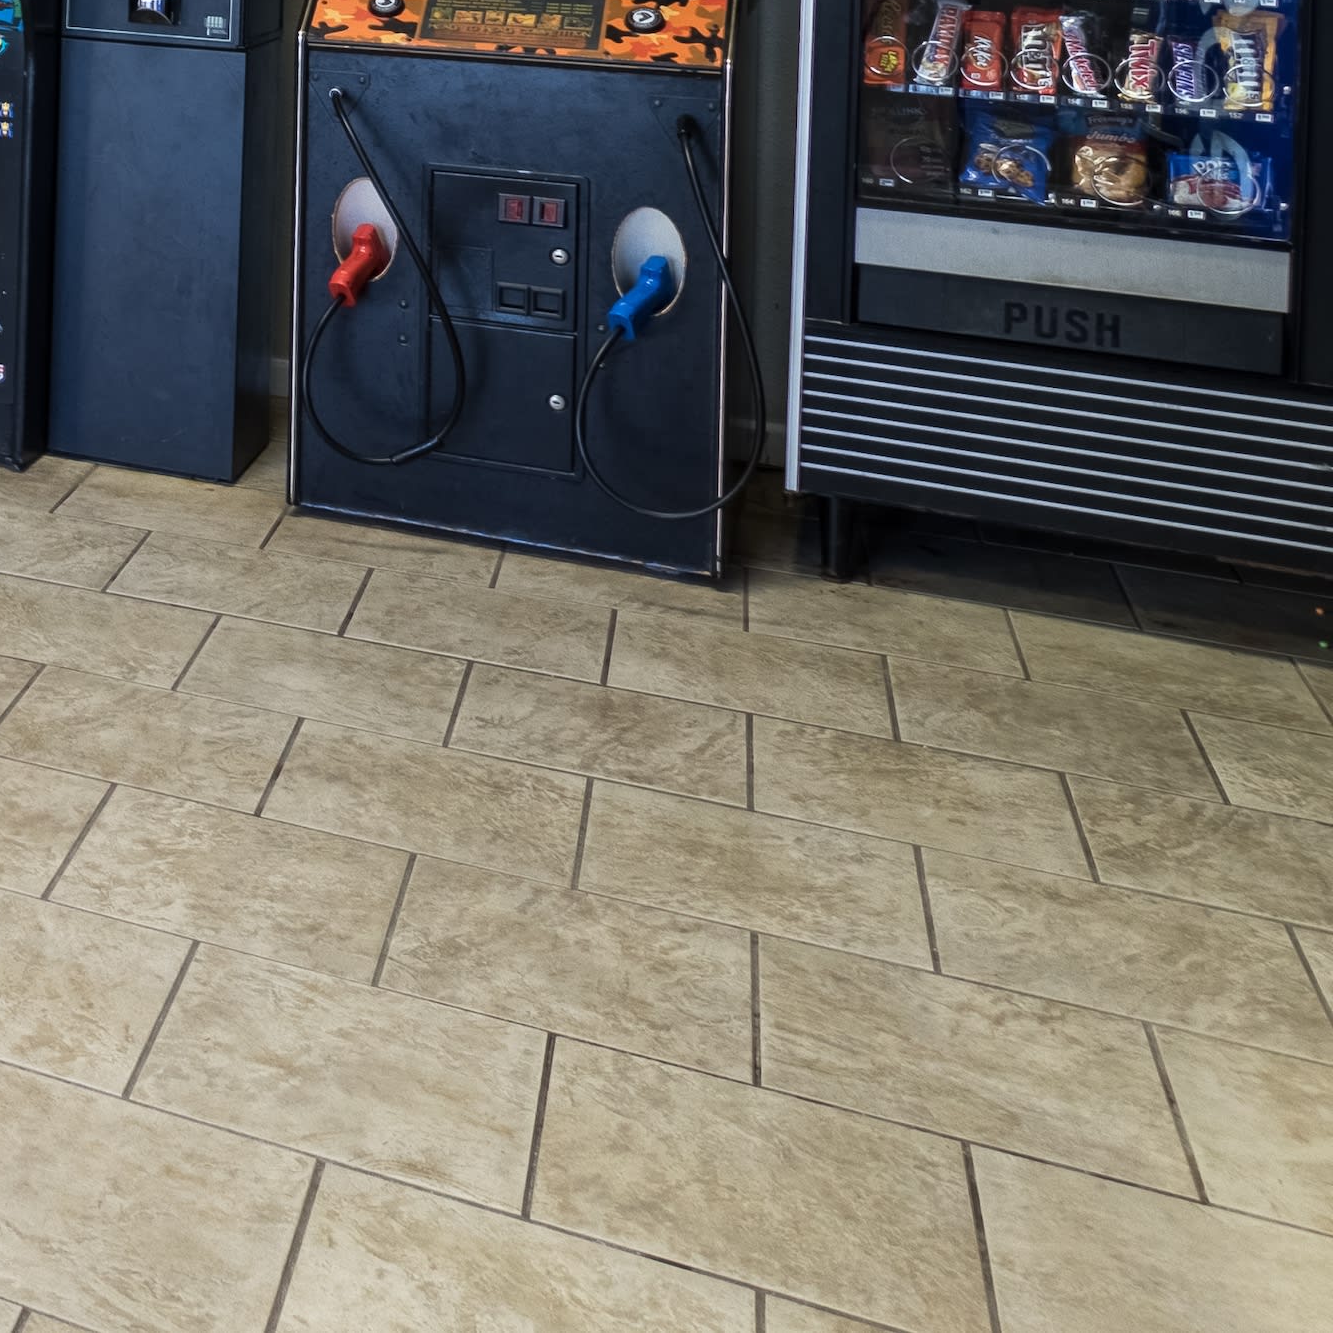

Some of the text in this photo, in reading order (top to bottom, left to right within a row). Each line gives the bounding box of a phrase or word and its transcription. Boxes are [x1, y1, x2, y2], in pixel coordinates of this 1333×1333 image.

[1172, 42, 1196, 102] SNICKERS
[1085, 130, 1135, 142] Jumbo
[1004, 301, 1120, 348] PUSH
